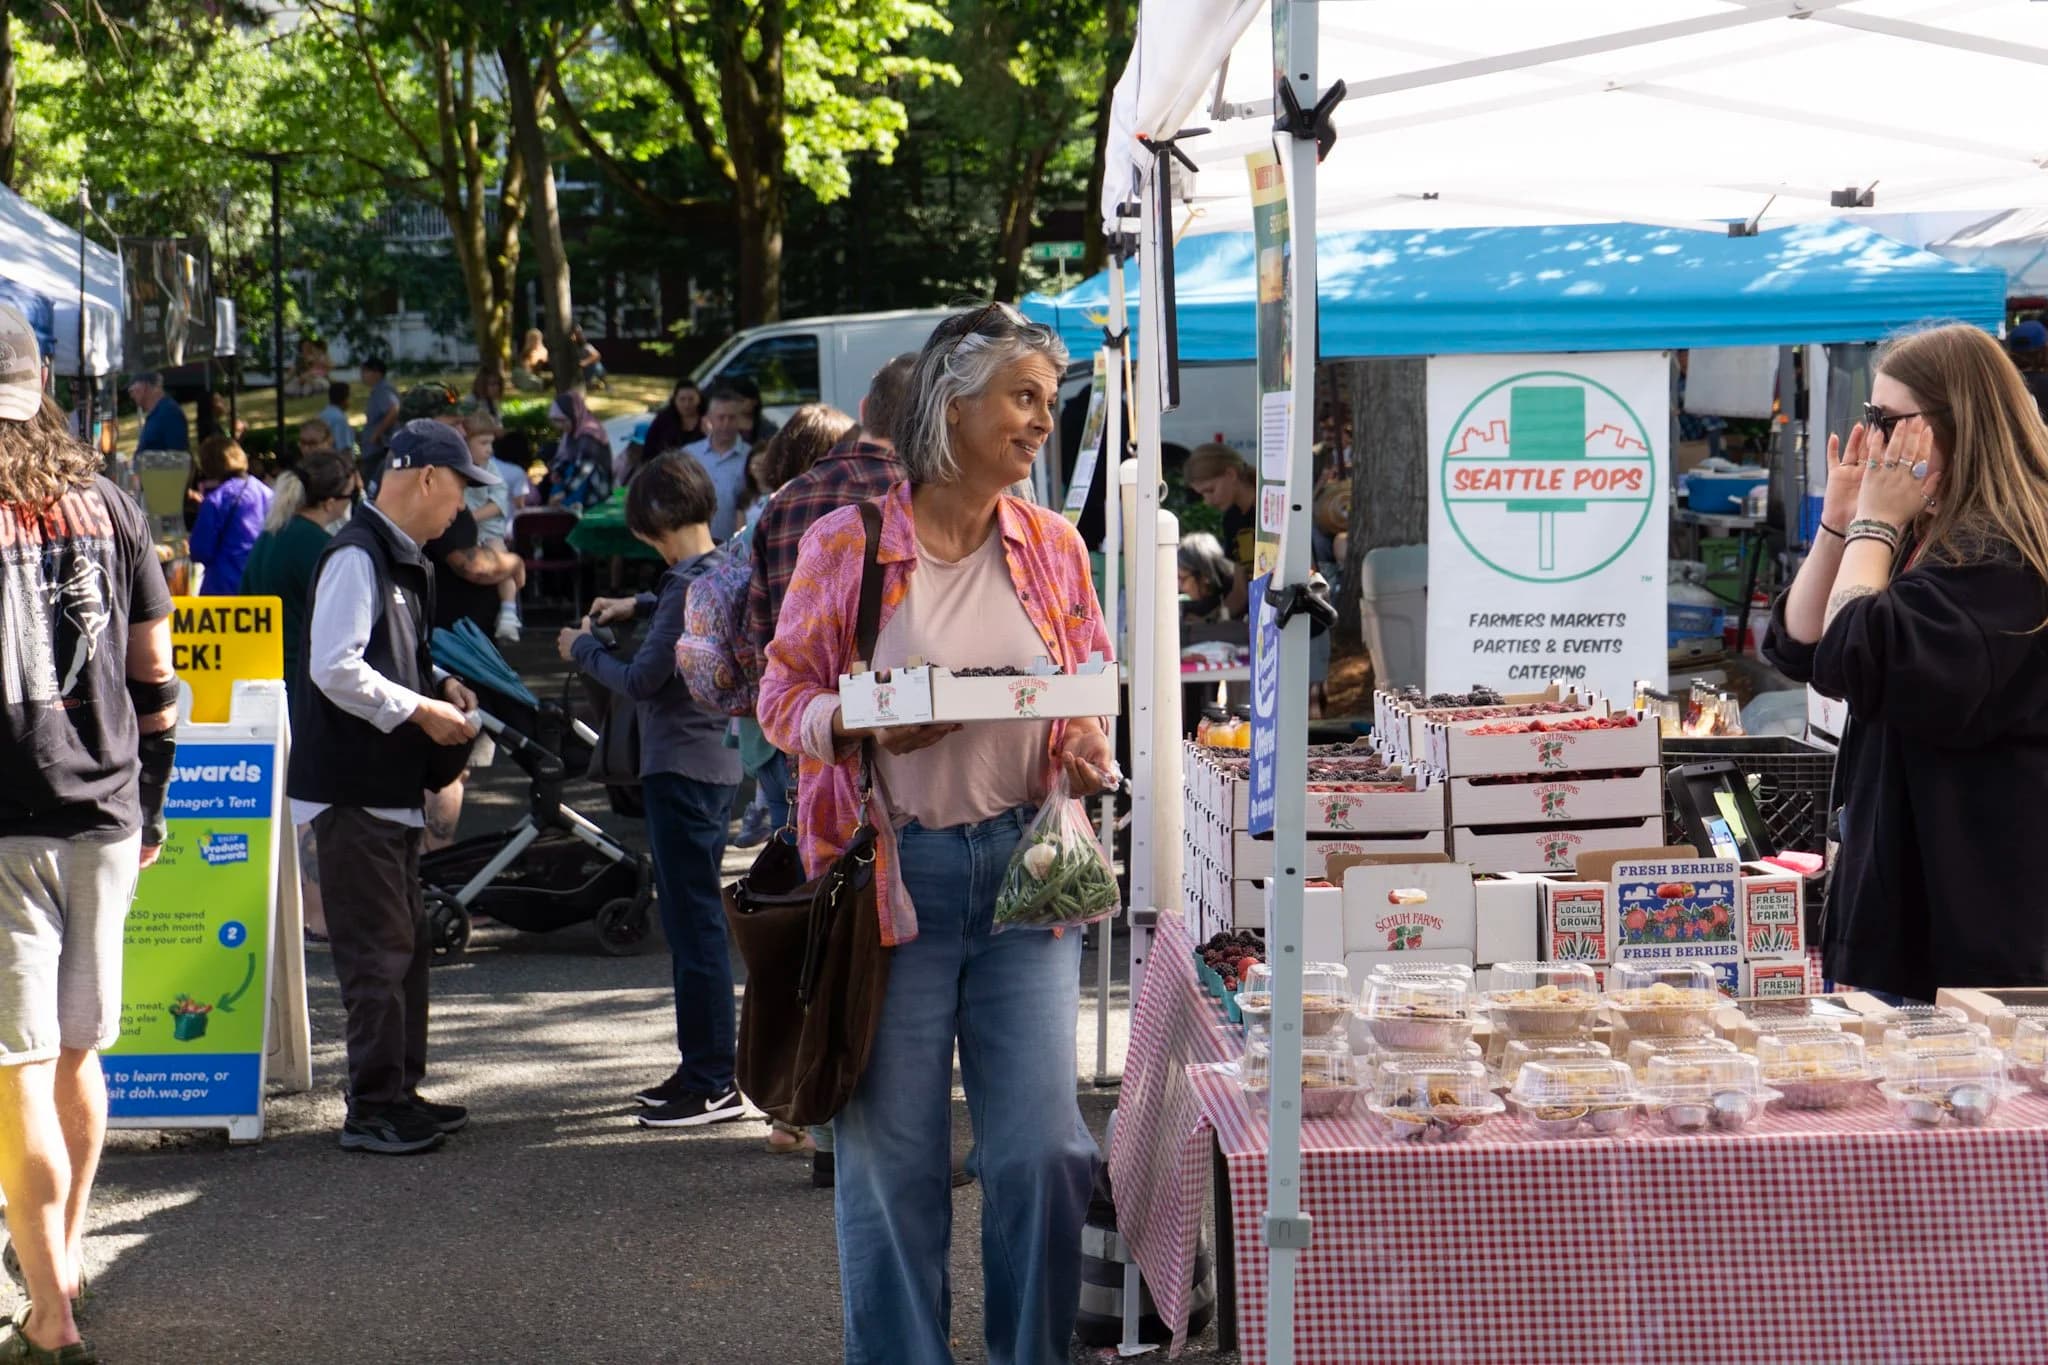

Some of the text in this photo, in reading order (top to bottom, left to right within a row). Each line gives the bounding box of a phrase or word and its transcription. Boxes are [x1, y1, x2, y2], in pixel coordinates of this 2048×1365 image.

[1453, 467, 1643, 491] SEATTLE POPS
[173, 607, 271, 633] MATCH
[1469, 613, 1626, 628] FARMERS MARKETS
[1472, 639, 1623, 653] PARTIES & EVENTS
[1508, 664, 1586, 680] CATERING
[228, 795, 256, 808] Tent
[1619, 863, 1734, 876] FRESH BERRIES
[1756, 895, 1789, 904] FRESH
[152, 912, 171, 921] you
[174, 910, 205, 921] spend
[1560, 905, 1597, 914] LOCALLY
[1757, 911, 1789, 920] FARM
[145, 923, 169, 931] each
[172, 923, 205, 931] month
[1375, 912, 1444, 933] SCHUH FARMS
[1560, 917, 1598, 927] GROWN
[227, 927, 238, 940] 2
[154, 937, 177, 946] your
[180, 935, 202, 944] card
[1623, 945, 1738, 959] FRESH BERRIES
[1763, 981, 1796, 989] FRESH
[136, 1002, 165, 1011] meat,
[137, 1013, 157, 1022] else
[115, 1072, 129, 1082] to
[132, 1070, 167, 1082] learn
[171, 1072, 209, 1083] more,
[214, 1071, 229, 1081] or
[129, 1086, 208, 1101] doh.wa.gov
